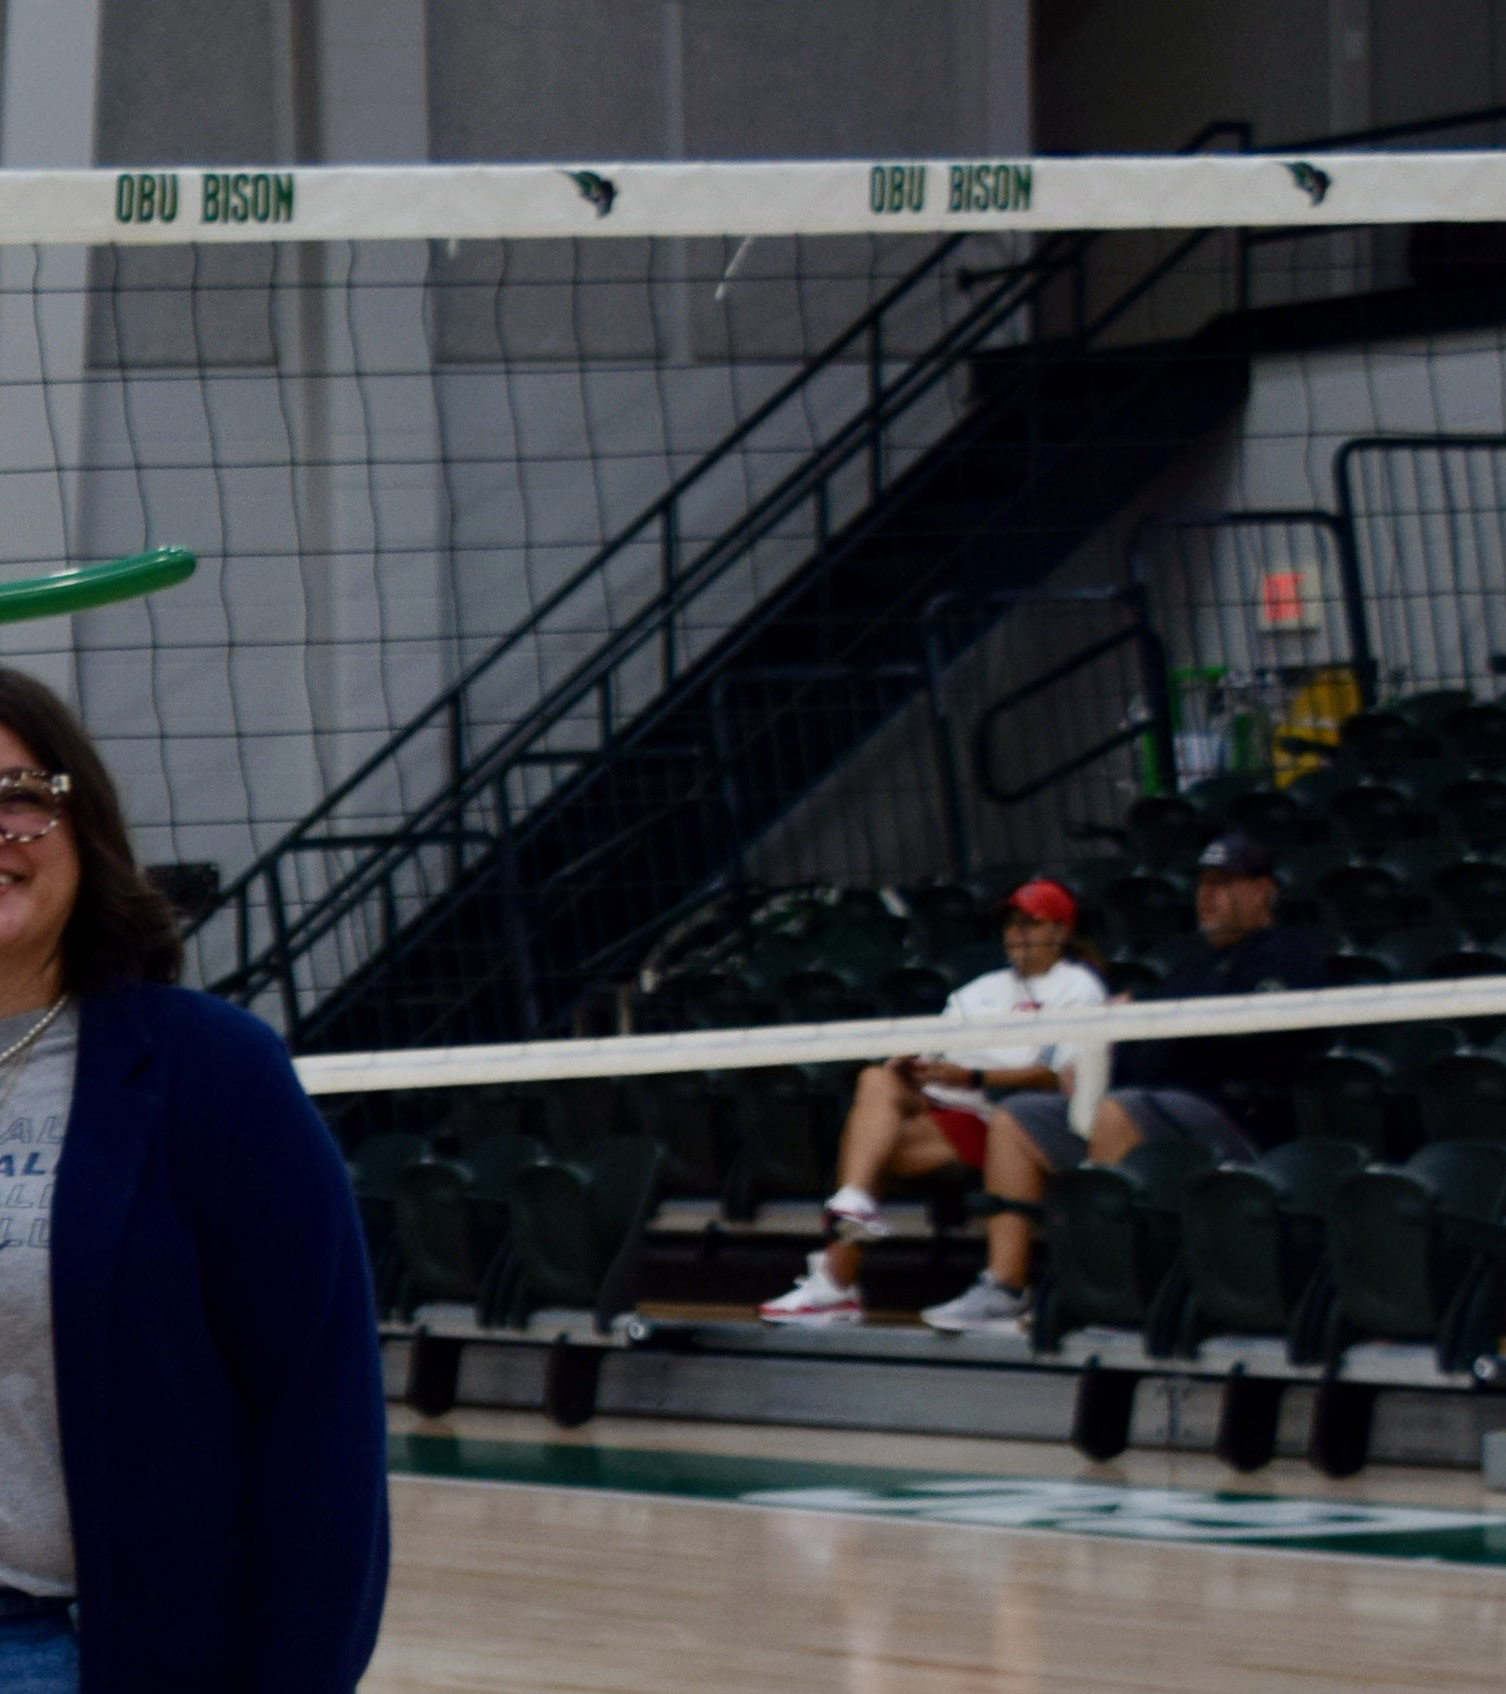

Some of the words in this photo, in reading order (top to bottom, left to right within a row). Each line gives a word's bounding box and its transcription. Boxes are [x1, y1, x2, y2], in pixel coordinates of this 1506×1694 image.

[116, 173, 179, 224] OBU
[200, 173, 294, 224] BISON
[870, 165, 926, 213] OBU
[946, 164, 1032, 212] BISON
